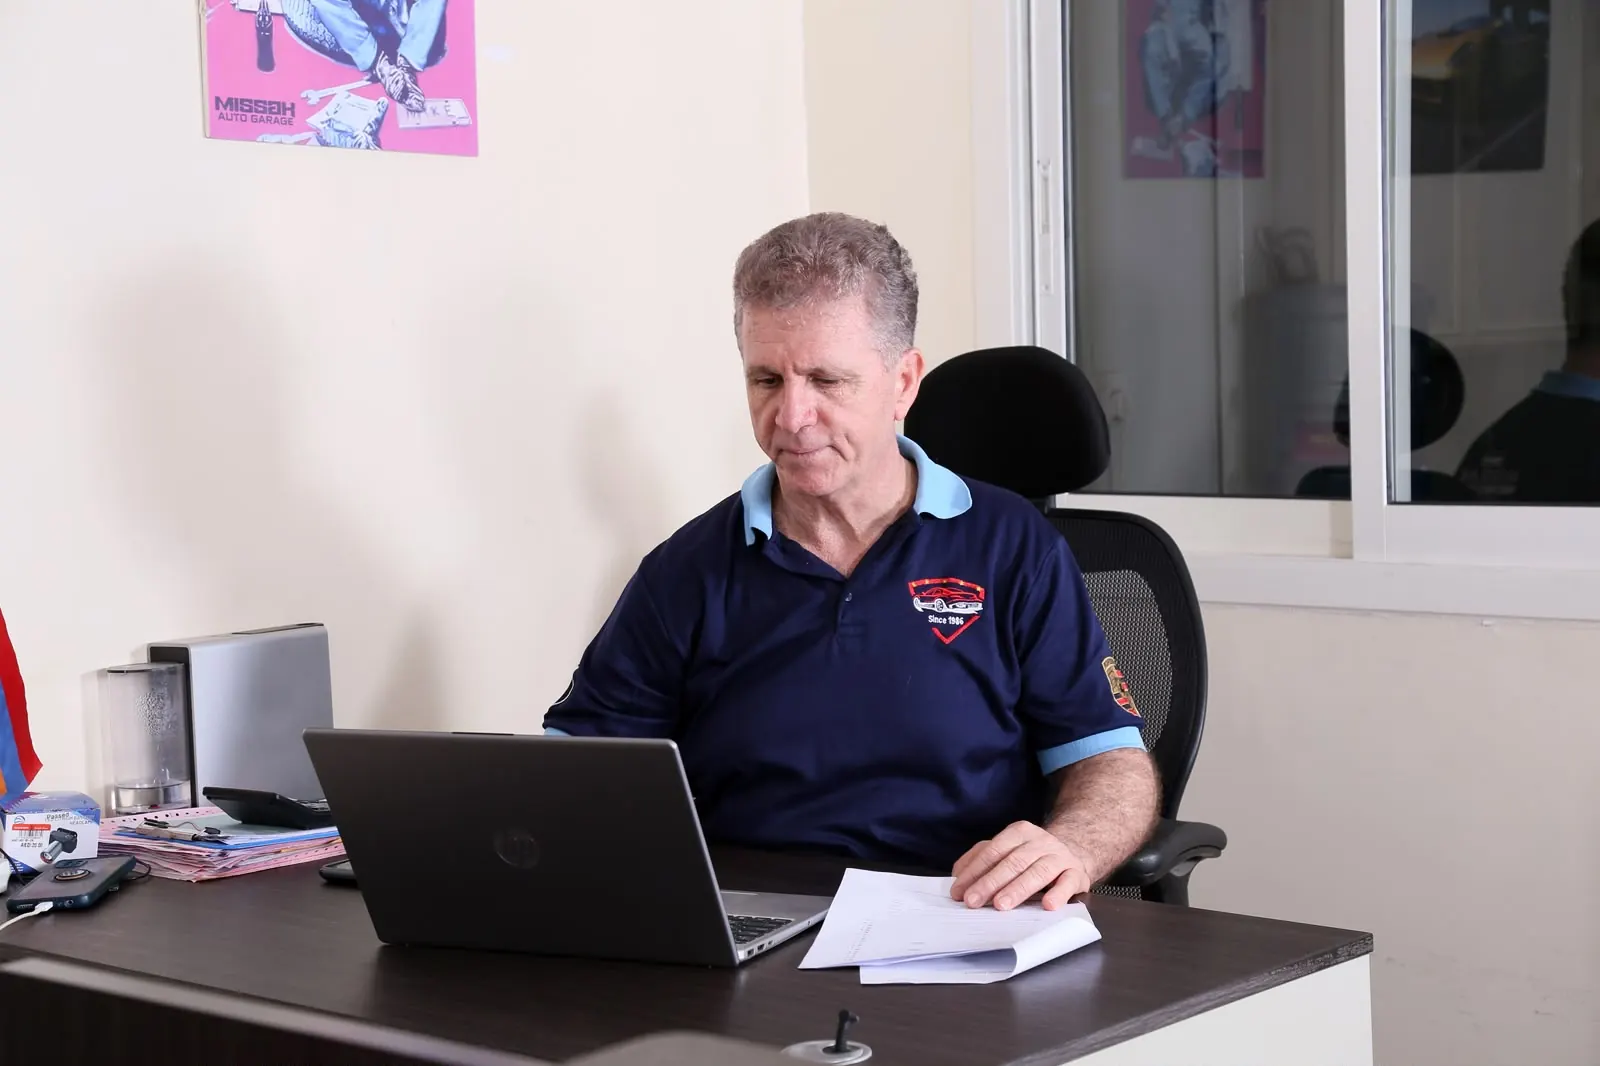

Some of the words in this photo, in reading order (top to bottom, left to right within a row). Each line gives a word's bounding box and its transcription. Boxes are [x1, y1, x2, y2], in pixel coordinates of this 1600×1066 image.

[218, 112, 247, 122] AUTO
[251, 114, 294, 126] GARAGE
[928, 615, 947, 624] Since
[948, 616, 964, 625] 1986
